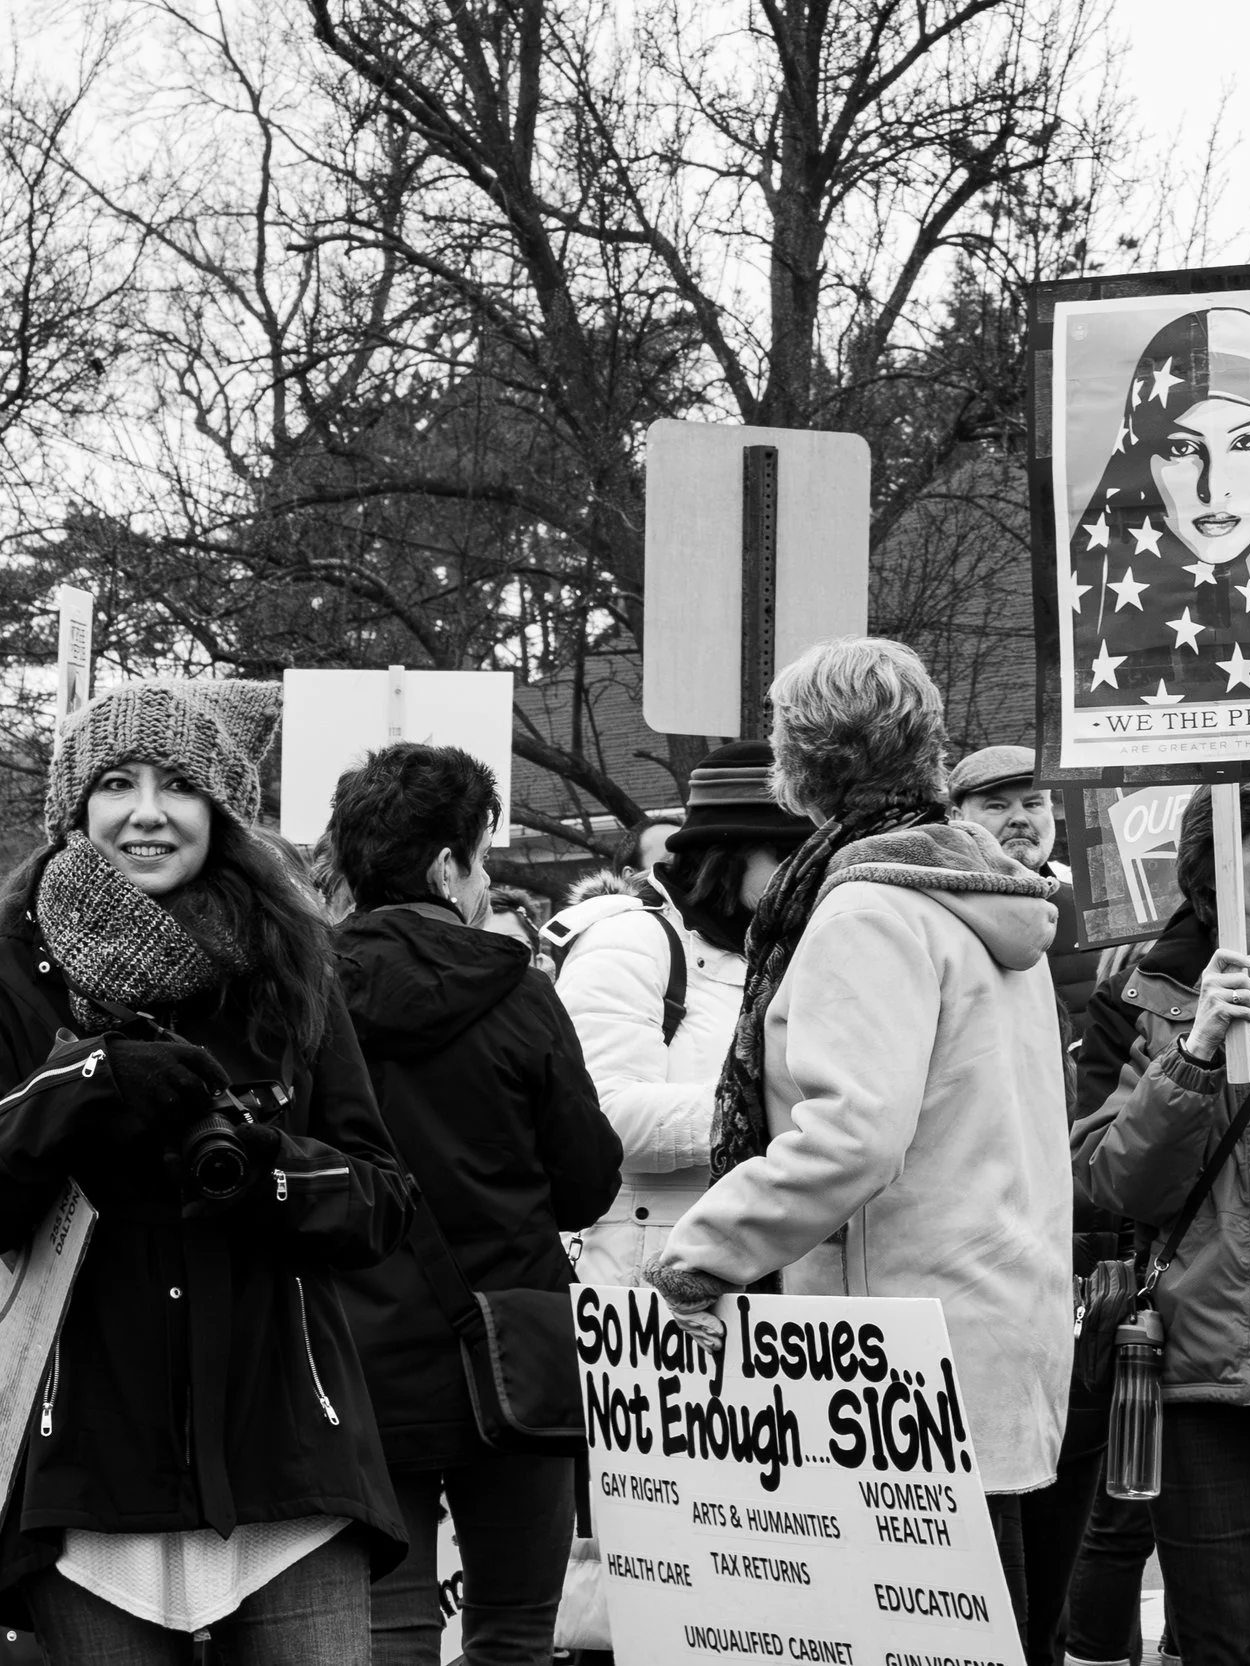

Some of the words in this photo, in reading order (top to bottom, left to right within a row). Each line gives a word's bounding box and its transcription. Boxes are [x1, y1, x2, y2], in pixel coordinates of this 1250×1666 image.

[1106, 713, 1153, 732] WE
[1162, 710, 1218, 730] THE
[1158, 740, 1228, 753] GREATER
[577, 1287, 622, 1367] So
[586, 1370, 653, 1455] Not
[601, 1471, 627, 1498] GAY
[630, 1475, 680, 1506] RIGHTS
[858, 1481, 958, 1513] WOMEN'S
[693, 1501, 727, 1528] ARTS
[730, 1504, 743, 1529] &
[746, 1508, 841, 1539] HUMANITIES
[875, 1515, 951, 1546] HEALTH
[607, 1553, 655, 1582] HEALTH
[657, 1560, 693, 1587] CARE
[710, 1551, 741, 1577] TAX
[742, 1555, 811, 1586] RETURNS
[873, 1583, 990, 1623] EDUCATION
[684, 1625, 784, 1657] UNQUALIFIED
[788, 1637, 853, 1666] CABINET
